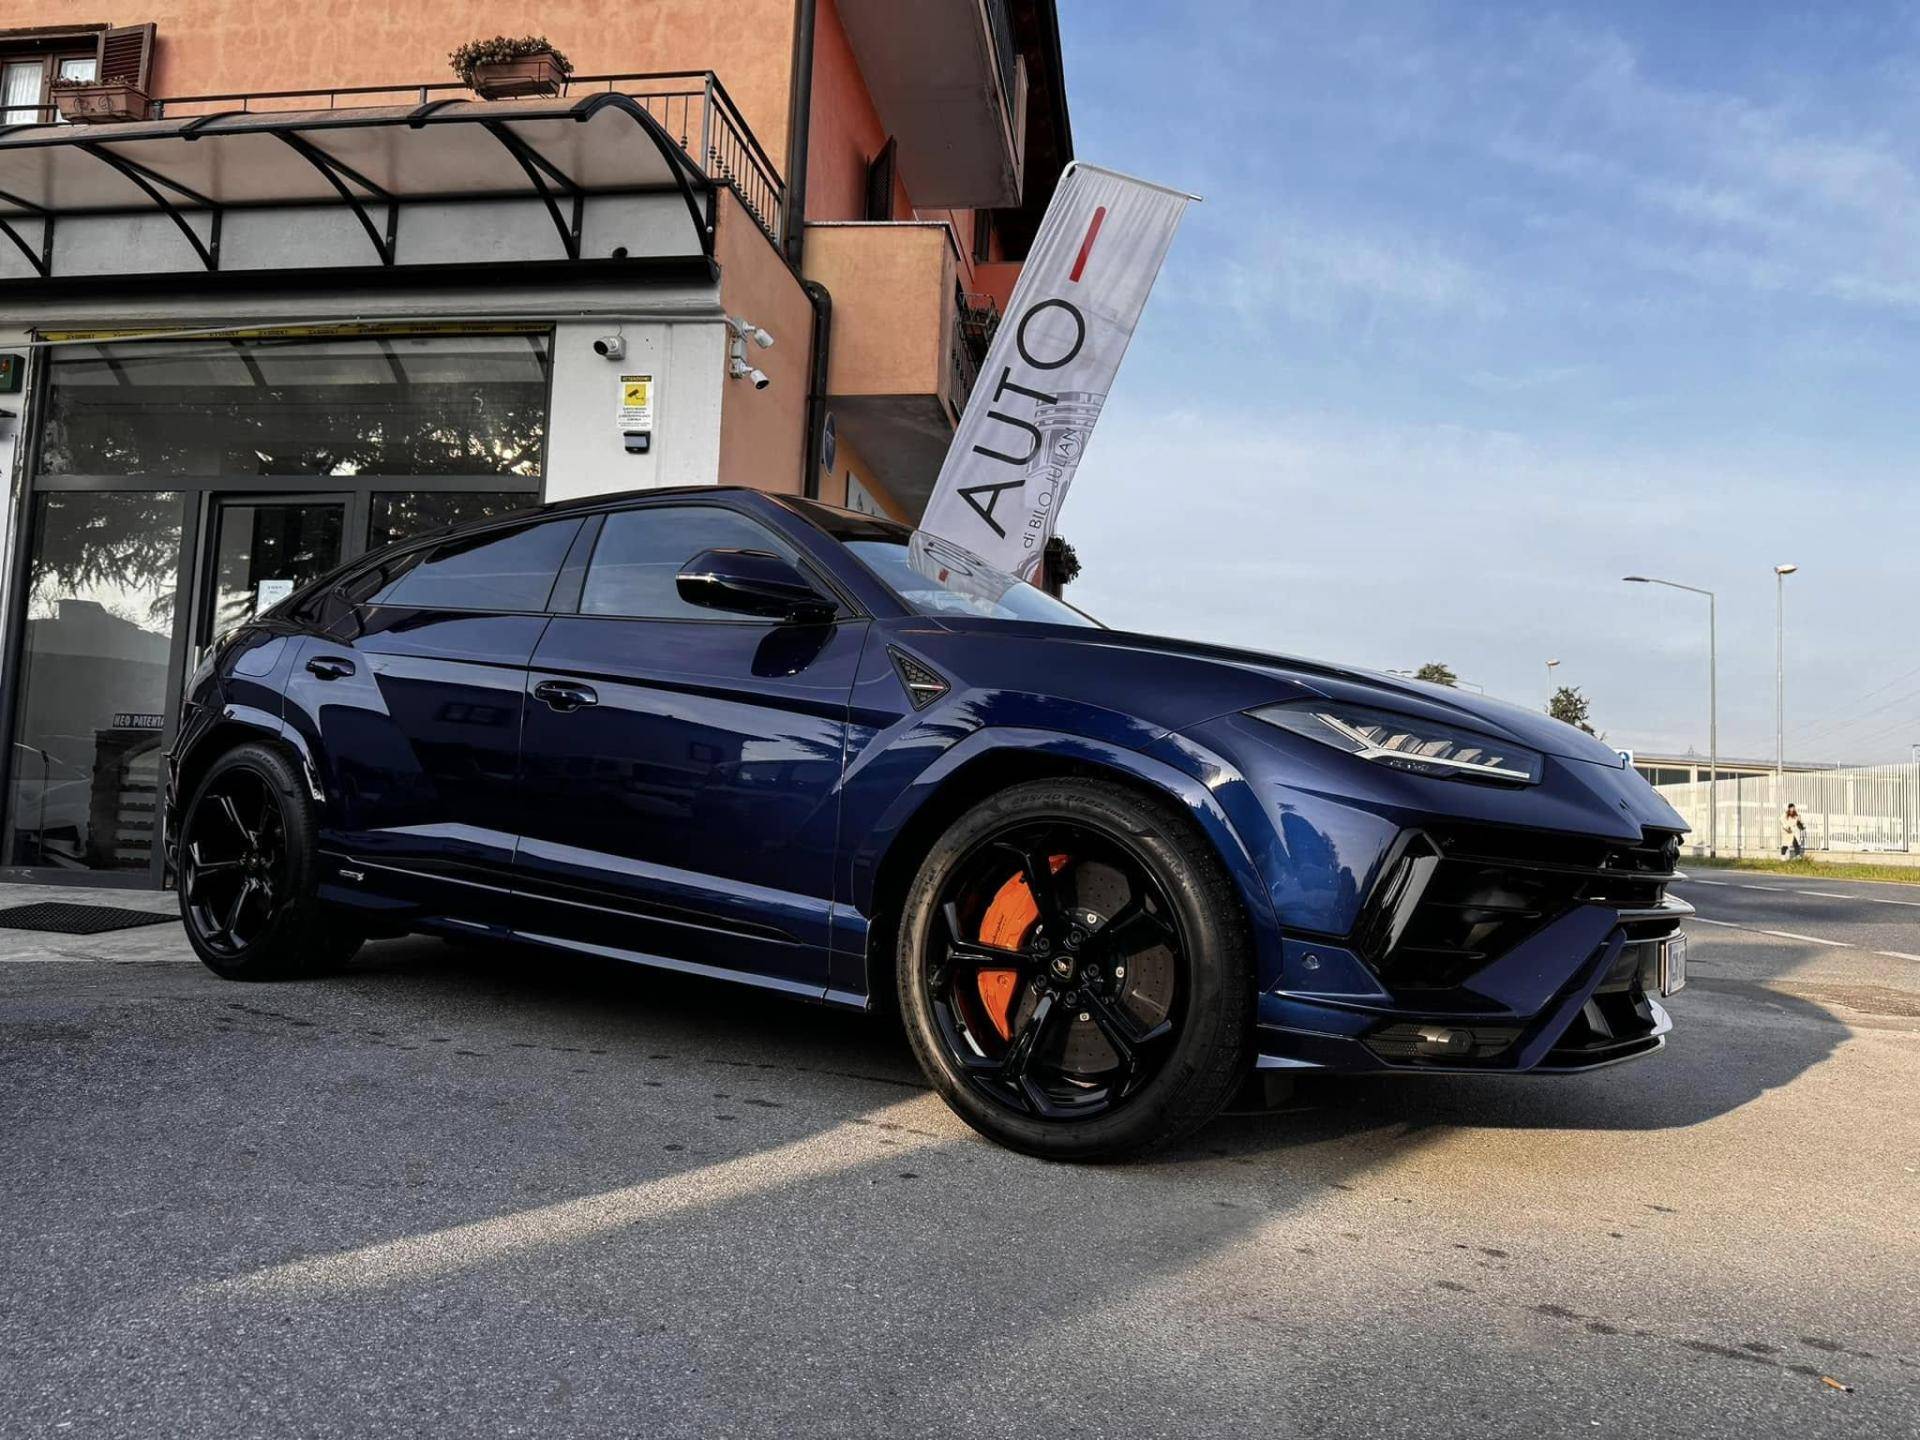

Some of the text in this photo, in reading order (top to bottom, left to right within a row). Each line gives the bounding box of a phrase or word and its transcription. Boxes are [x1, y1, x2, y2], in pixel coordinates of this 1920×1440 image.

[956, 298, 1086, 540] AUTO
[1023, 427, 1077, 549] di BILO JULIAN
